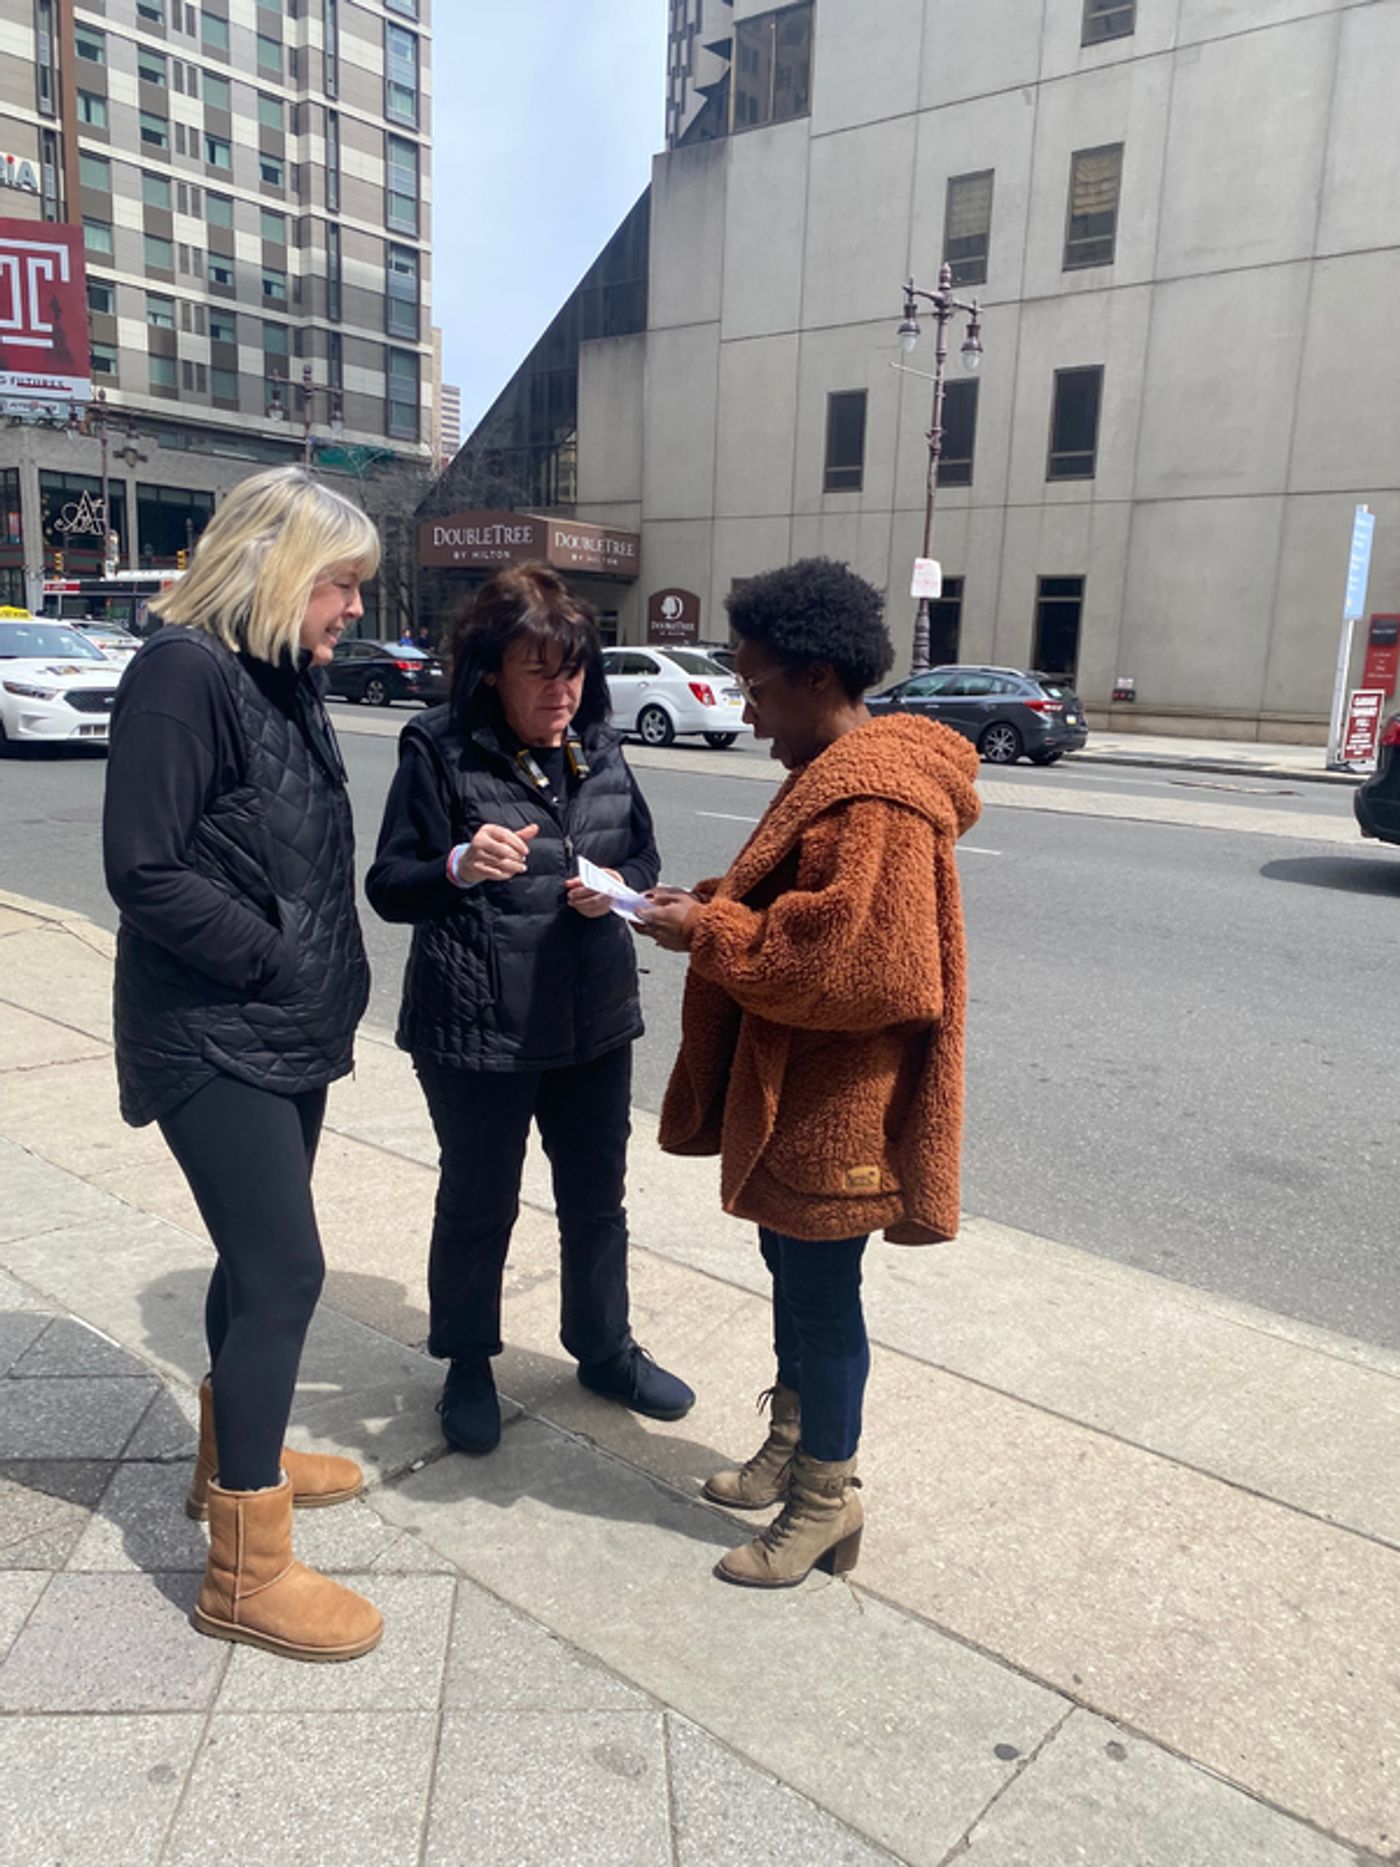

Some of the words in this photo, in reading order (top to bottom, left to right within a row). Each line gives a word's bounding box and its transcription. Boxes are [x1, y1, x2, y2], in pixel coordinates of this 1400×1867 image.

[10, 376, 65, 388] FUTURES
[433, 524, 533, 545] DOUBLETREE
[555, 531, 636, 557] DOUBLETREE
[453, 550, 468, 560] BY
[472, 550, 511, 560] HILTON
